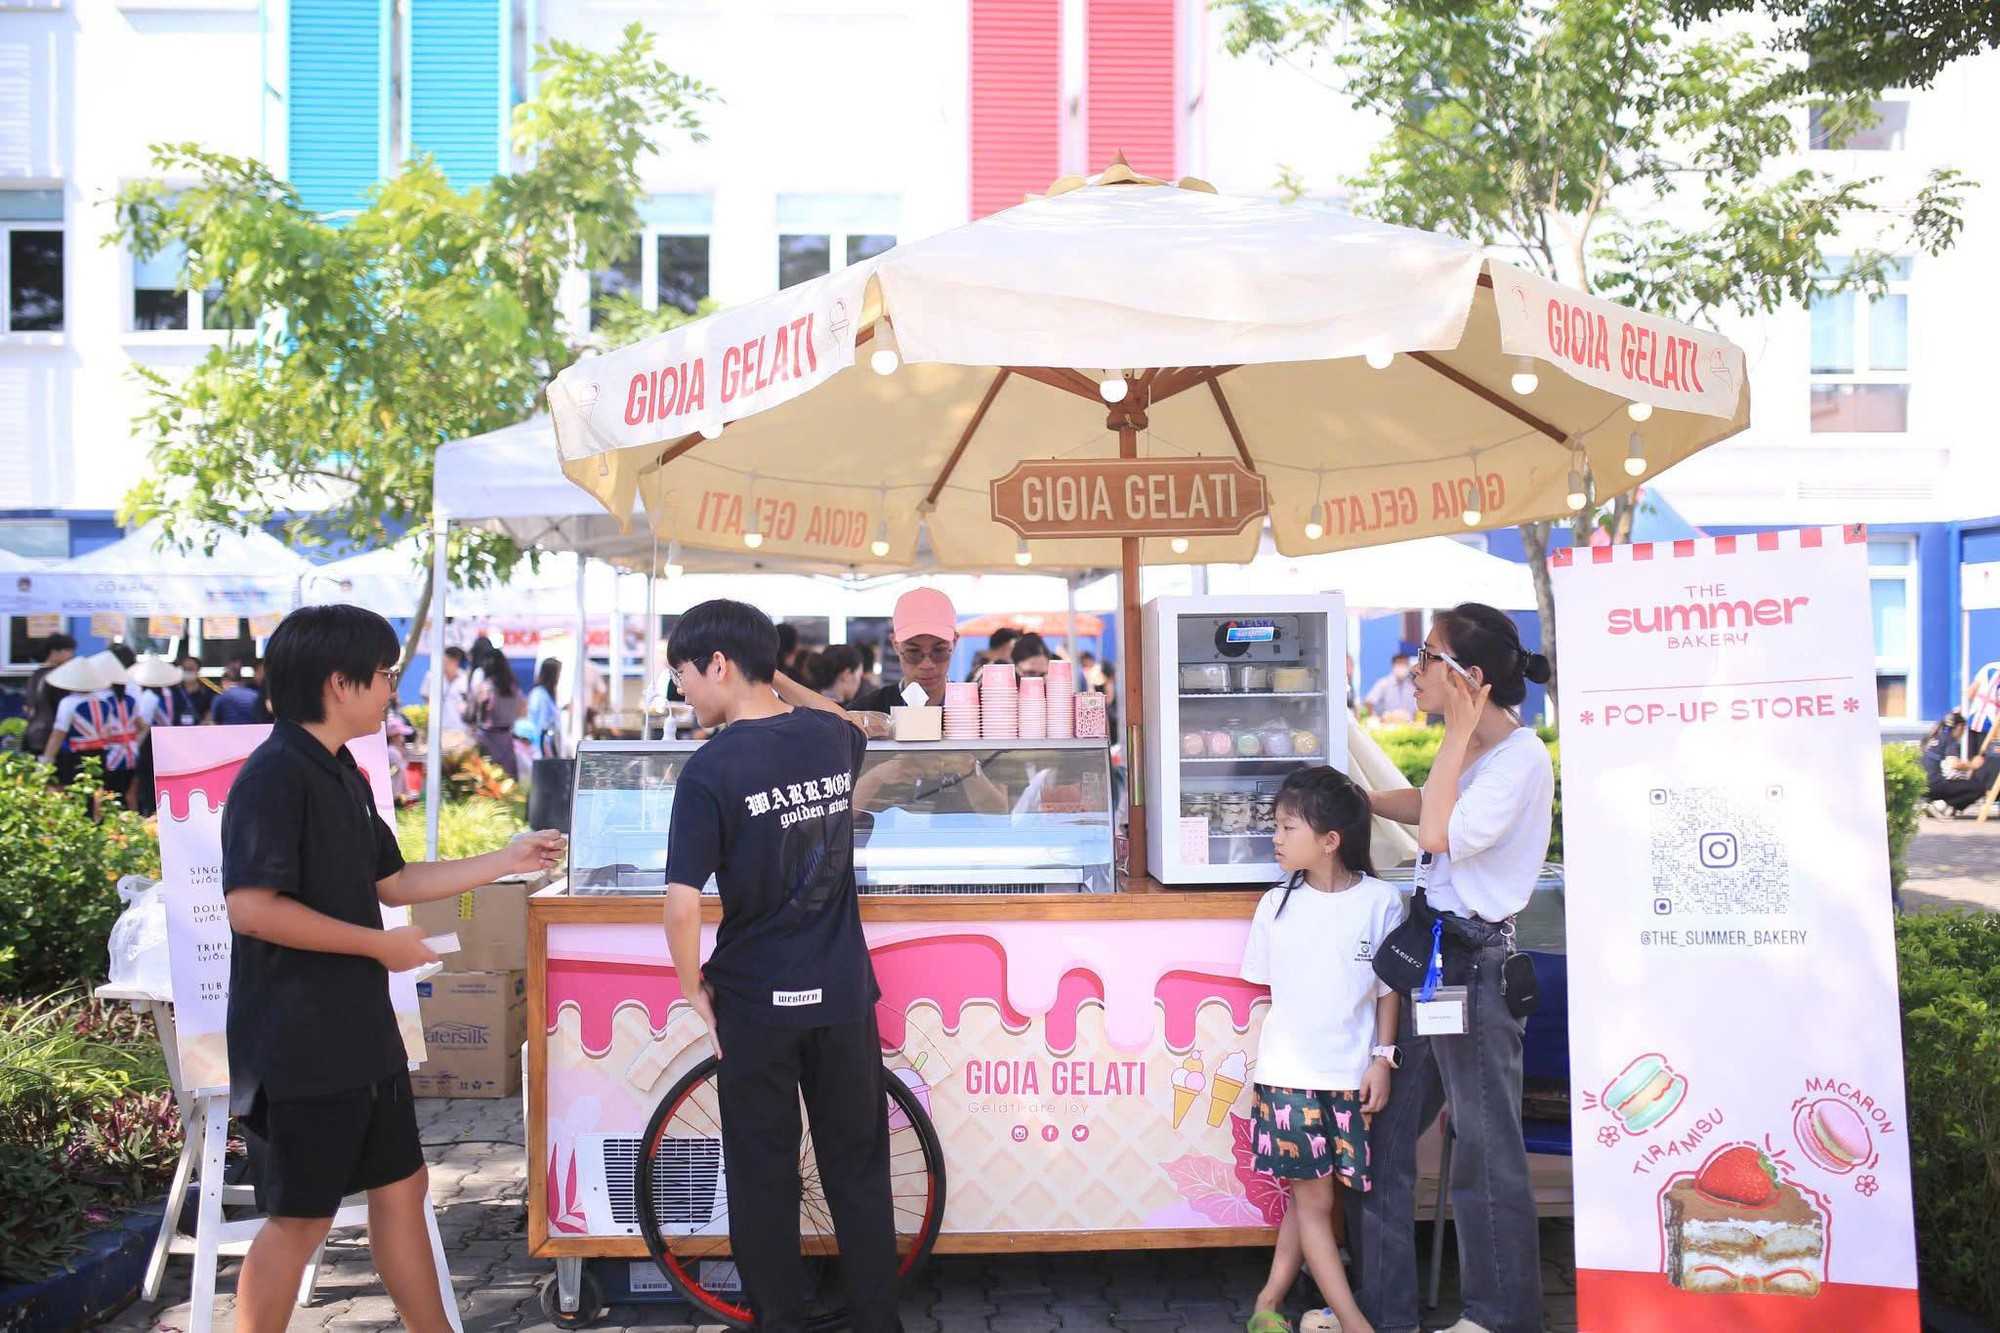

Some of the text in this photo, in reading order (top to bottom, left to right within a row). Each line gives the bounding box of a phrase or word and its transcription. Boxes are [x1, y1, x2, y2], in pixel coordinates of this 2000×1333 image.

[1547, 298, 1705, 393] GIOIA GELATI
[624, 312, 817, 426] GIOIA GELATI
[1022, 473, 1238, 522] GIOIA GELATI
[1684, 583, 1728, 599] THE
[1607, 596, 1810, 635] summer
[1667, 632, 1749, 650] BAKERY
[1605, 694, 1835, 726] POP-UP STORE
[780, 804, 825, 829] golden
[1640, 930, 1808, 947] @THE_SUMMER_BAKERY
[200, 982, 222, 991] TUB
[778, 993, 818, 1003] western
[424, 1026, 489, 1044] atersilk
[966, 1060, 1146, 1096] GIOIA GELATI
[968, 1101, 1089, 1116] Gelati are joy
[1805, 1077, 1895, 1135] MACARON
[1632, 1107, 1724, 1177] TIRAMISU
